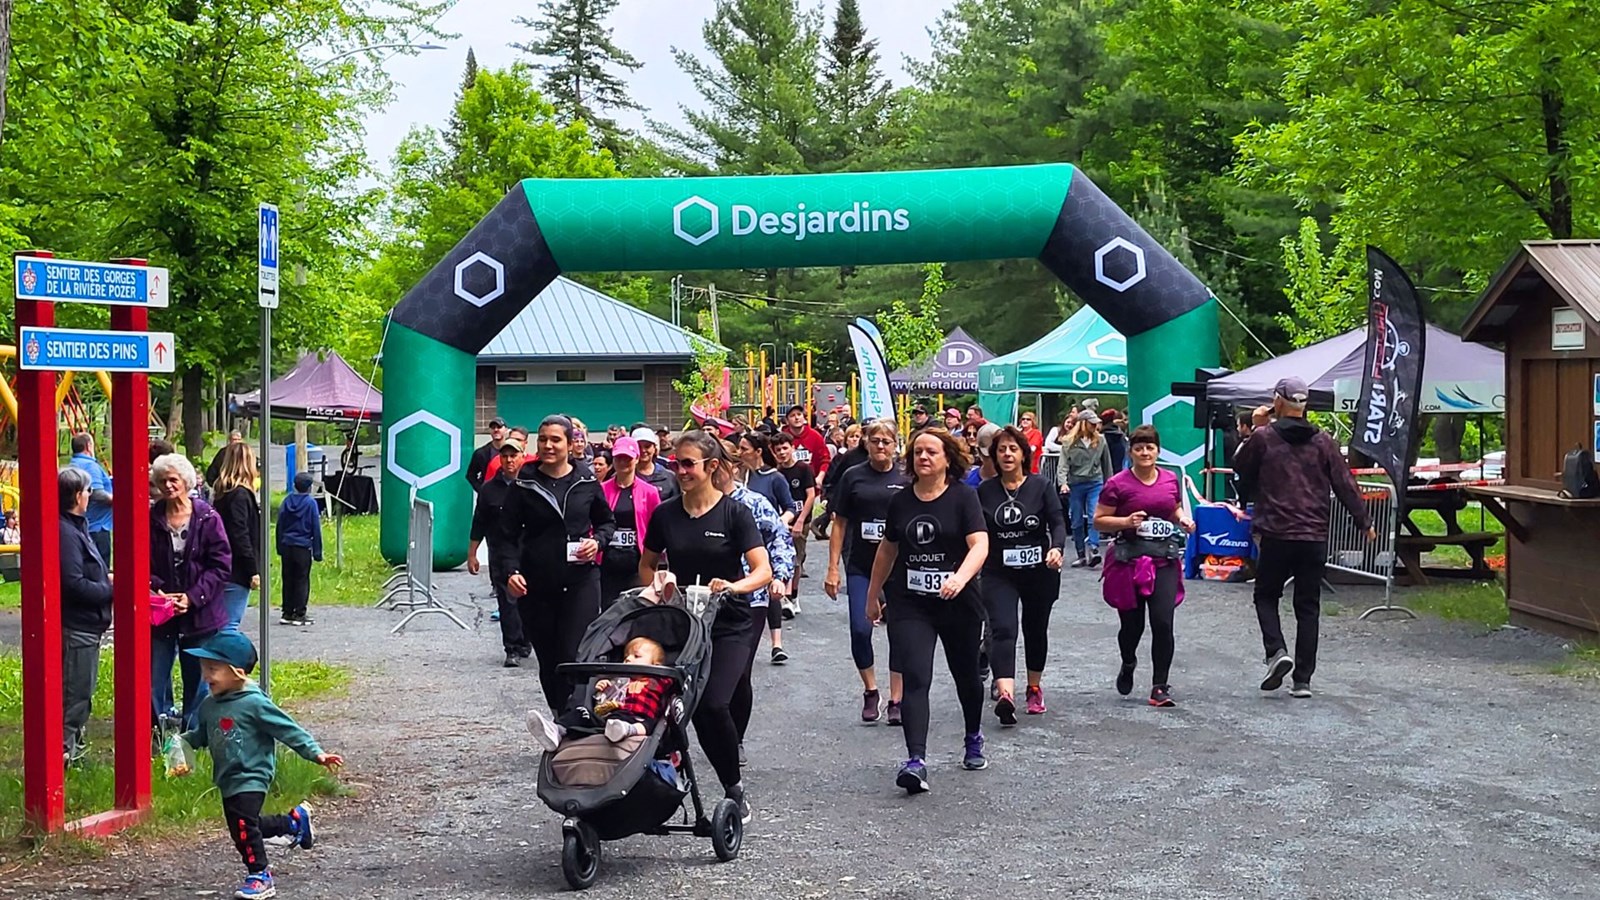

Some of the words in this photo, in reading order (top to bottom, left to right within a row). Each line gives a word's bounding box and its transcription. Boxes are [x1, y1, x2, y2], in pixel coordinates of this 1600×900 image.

[731, 201, 910, 241] Desjardins
[46, 265, 80, 281] SENTIER
[84, 268, 100, 283] DES
[103, 270, 136, 285] GORGES
[46, 280, 58, 294] DE
[61, 281, 72, 295] LA
[108, 285, 136, 299] POZER
[46, 340, 87, 359] SENTIER
[89, 343, 110, 359] DES
[112, 343, 138, 360] PINS
[947, 348, 973, 366] D
[909, 552, 946, 562] DUQUET
[1020, 548, 1040, 564] 925
[924, 573, 949, 590] 93
